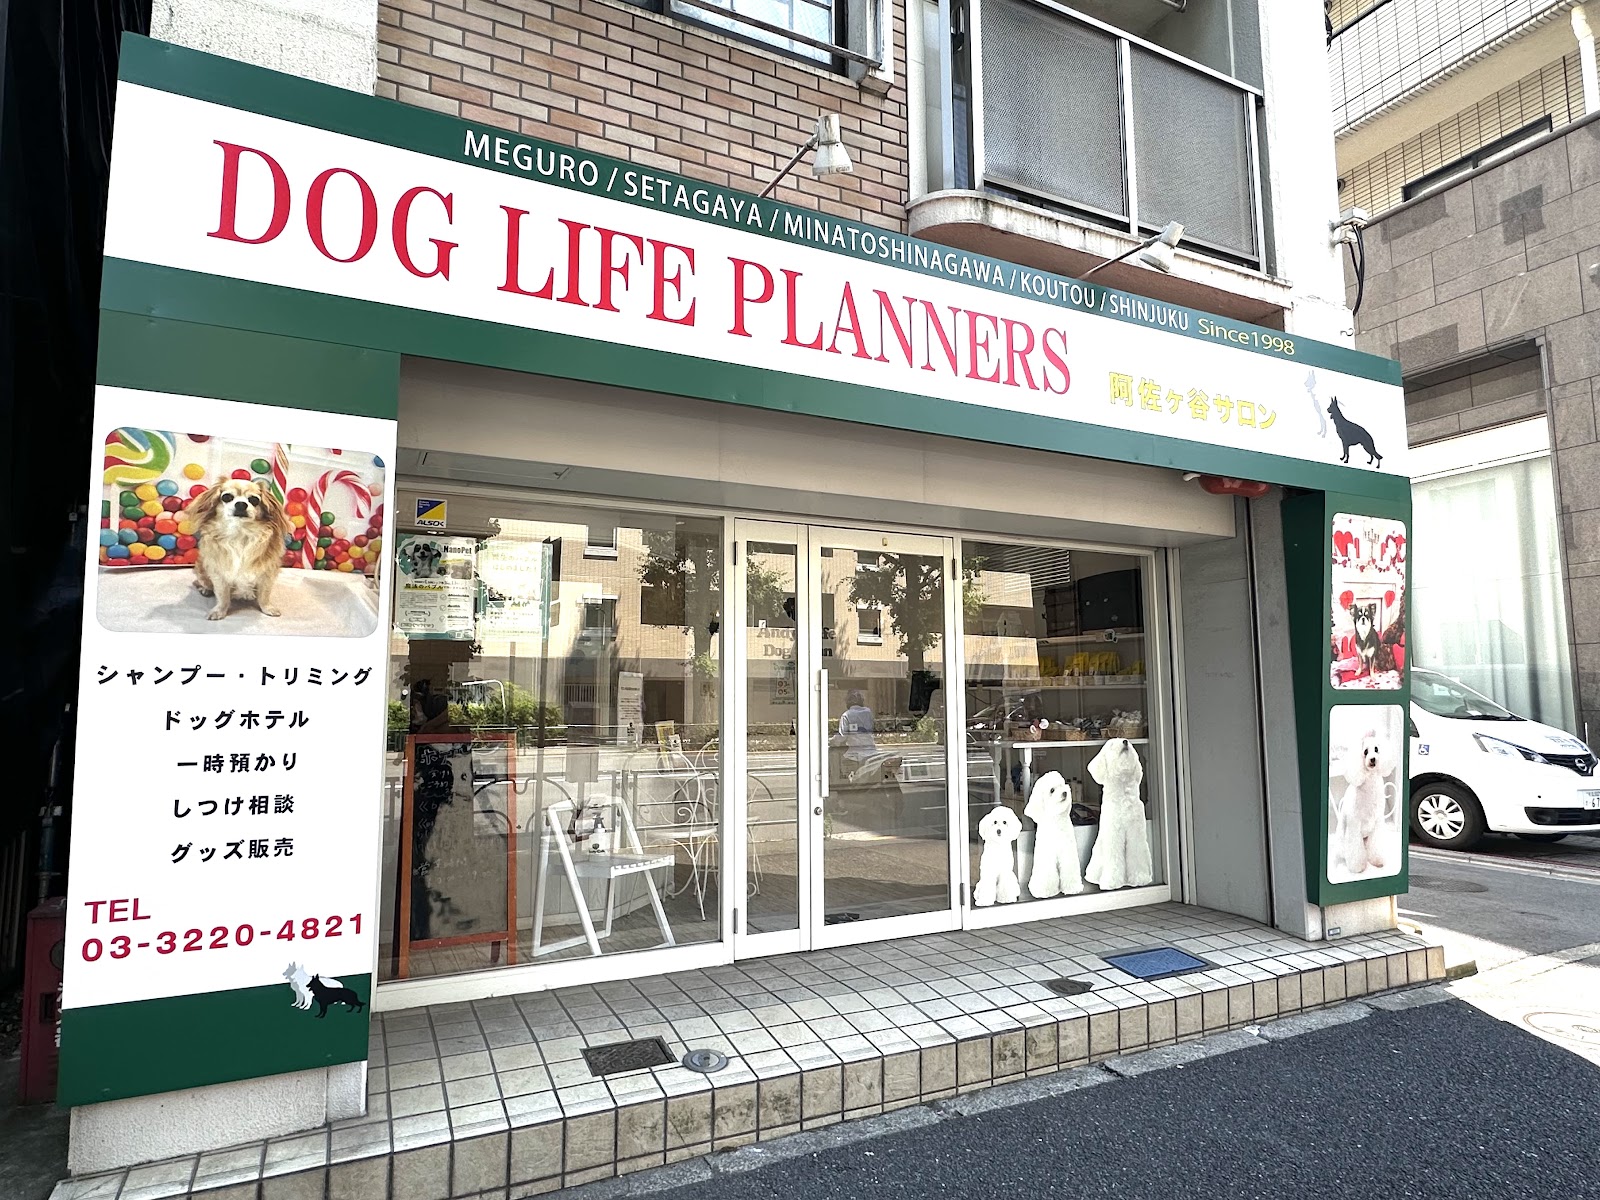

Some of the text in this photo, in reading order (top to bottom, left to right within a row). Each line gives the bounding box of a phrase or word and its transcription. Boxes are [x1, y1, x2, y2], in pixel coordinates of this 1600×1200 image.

[464, 129, 599, 187] MEGURO
[623, 171, 763, 228] SETAGAYA
[783, 211, 1005, 287] MINATOSHINAGAWA
[1019, 271, 1096, 309] KOUTOU
[1109, 293, 1191, 332] SHINJUKU
[207, 140, 1072, 396] DOG LIFE PLANNERS
[1109, 371, 1277, 431] 阿佐ヶ谷サロン
[416, 519, 444, 527] ALSOK
[97, 664, 373, 686] シャンプー・トリミング
[165, 709, 310, 731] ドッグホテル
[177, 752, 298, 773] 一時預かり
[173, 794, 295, 819] しつけ相談
[171, 837, 294, 864] グッズ販売
[84, 897, 151, 924] TEL
[81, 913, 363, 962] 03-3220-4821
